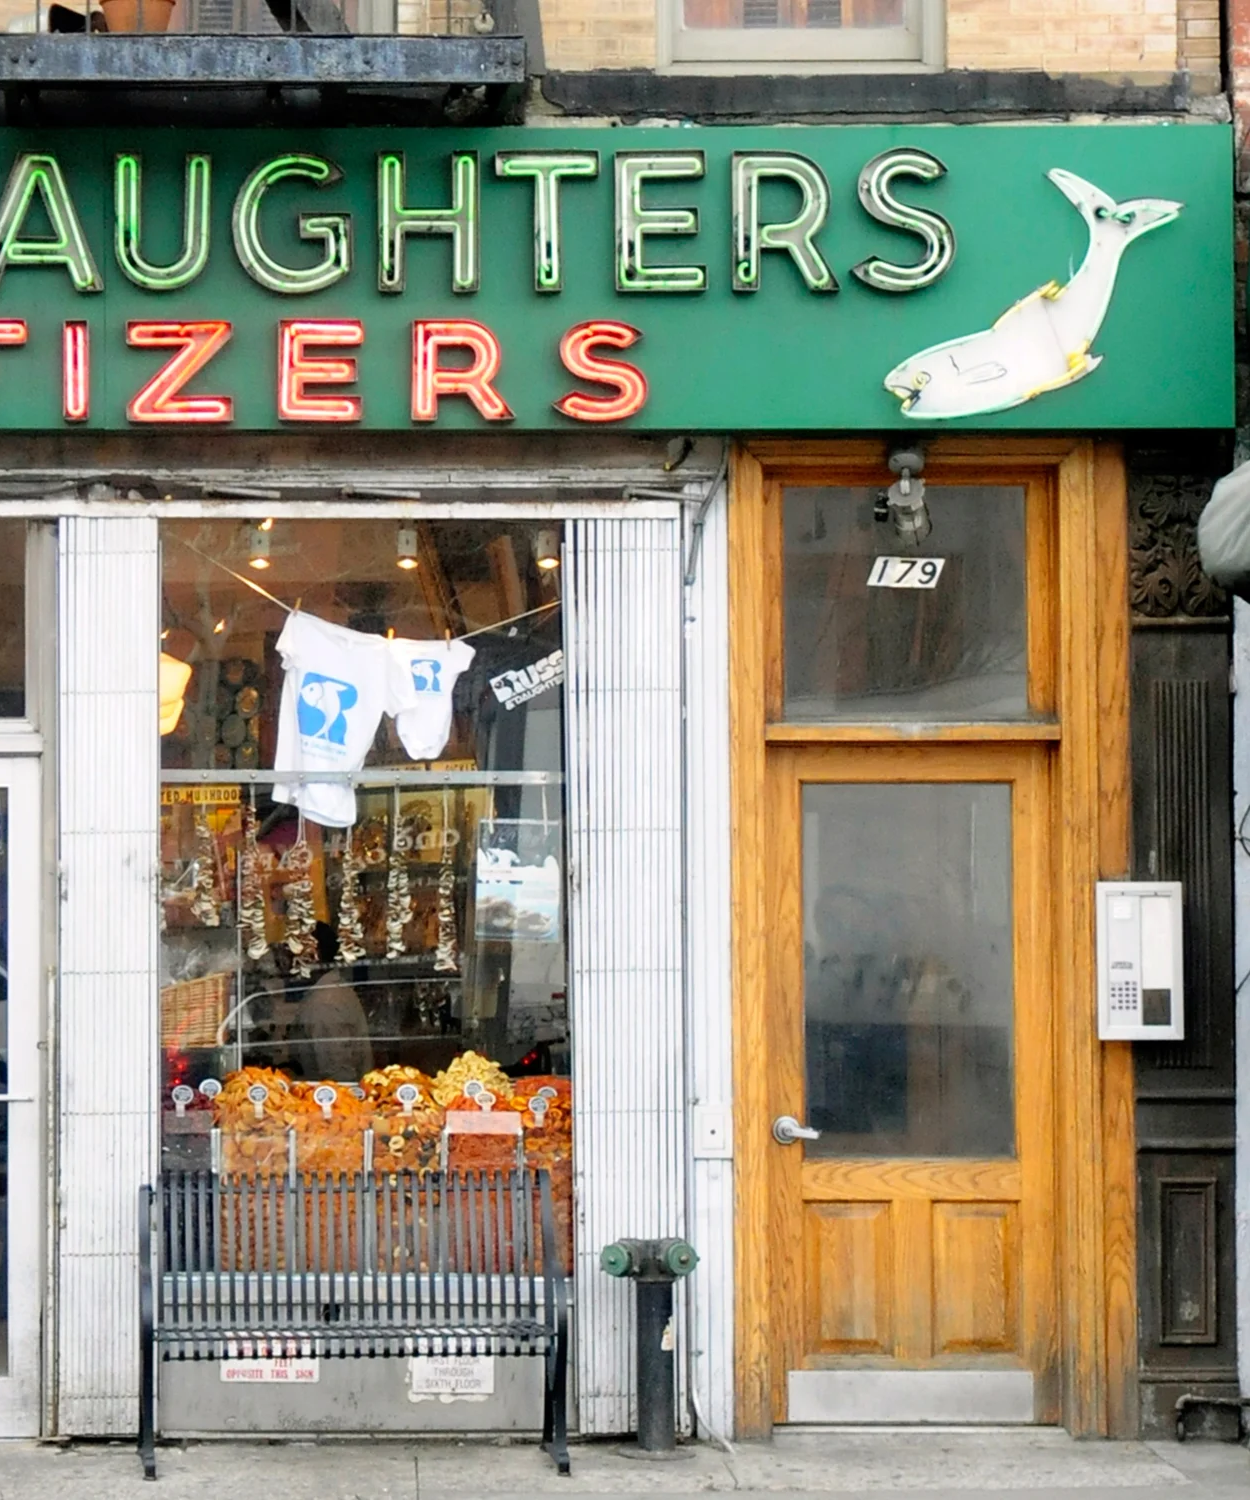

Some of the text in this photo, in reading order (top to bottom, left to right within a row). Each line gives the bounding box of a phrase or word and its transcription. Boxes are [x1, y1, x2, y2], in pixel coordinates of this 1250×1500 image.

[876, 559, 938, 585] 179
[226, 1368, 315, 1380] OPPOSITE THIS SIGN
